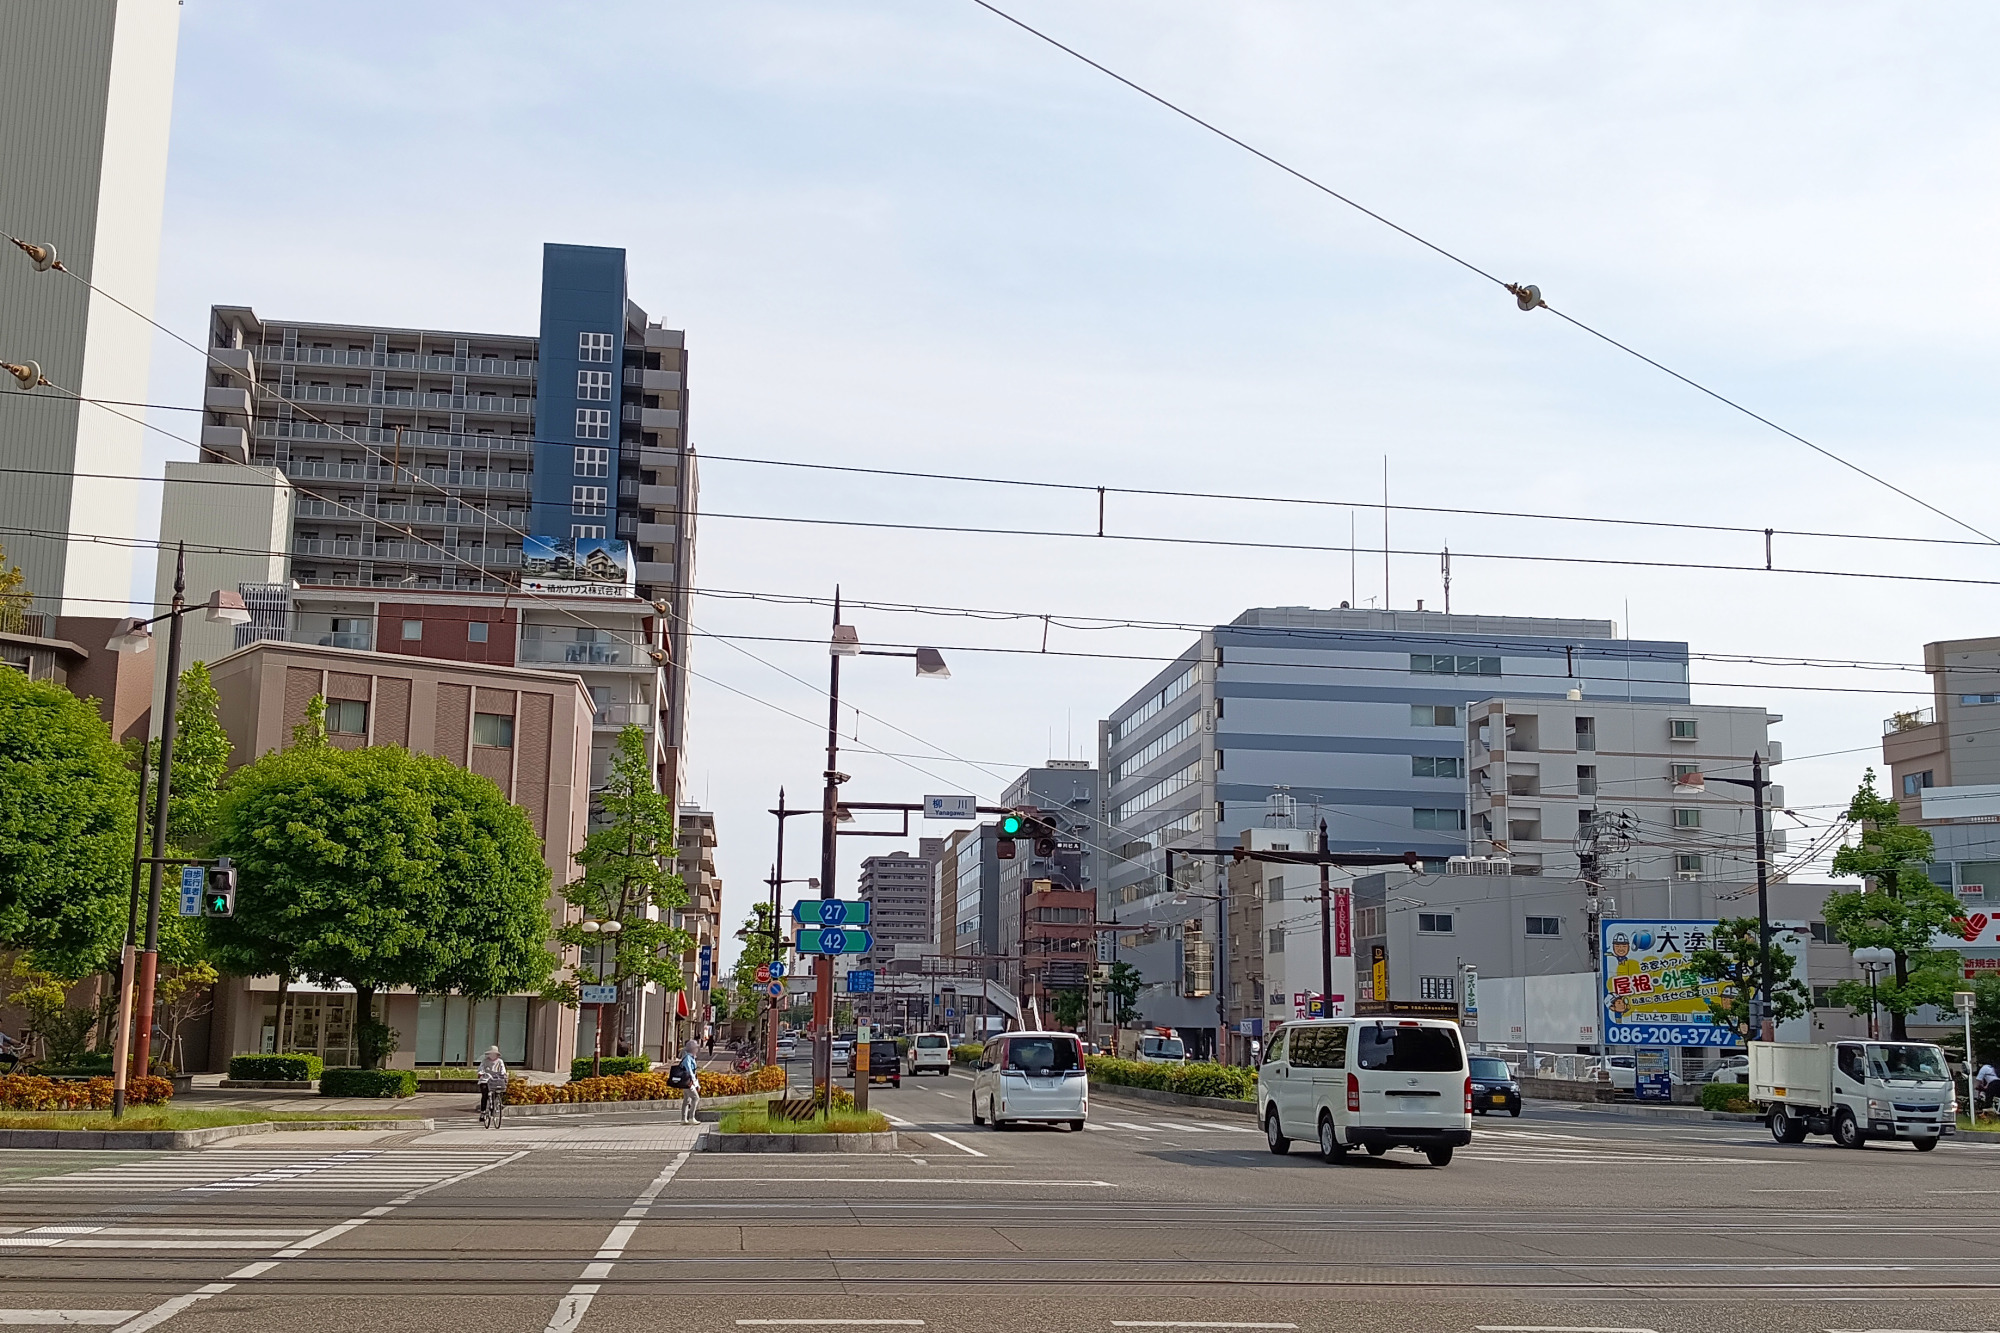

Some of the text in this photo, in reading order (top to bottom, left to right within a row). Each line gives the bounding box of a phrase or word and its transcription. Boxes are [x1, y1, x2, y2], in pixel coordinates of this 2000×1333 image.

[547, 584, 622, 596] 積水ハウス株式会社
[935, 809, 966, 817] Yanagawa
[192, 870, 202, 895] 歩行者
[185, 896, 195, 913] 専用
[825, 905, 842, 920] 27
[824, 934, 841, 949] 42
[1964, 958, 2000, 969] 新規会
[1311, 1002, 1322, 1012] P
[1636, 1013, 1668, 1022] だいとや
[1608, 1027, 1732, 1045] 086-206-3747
